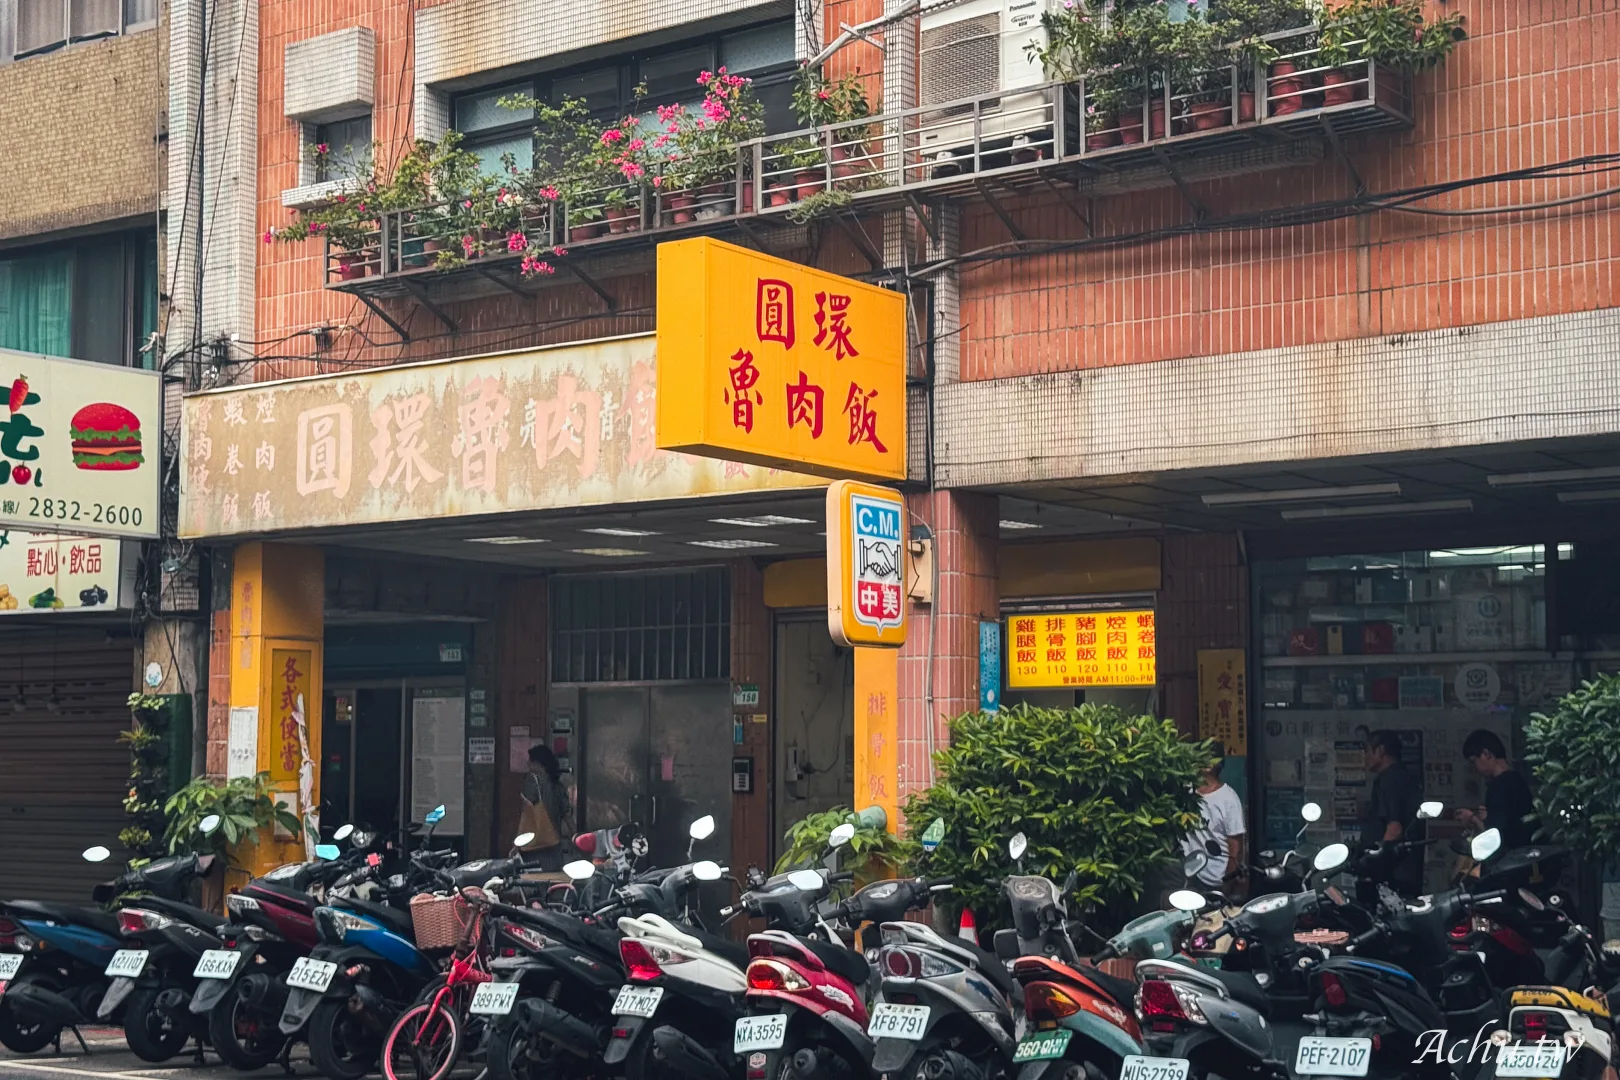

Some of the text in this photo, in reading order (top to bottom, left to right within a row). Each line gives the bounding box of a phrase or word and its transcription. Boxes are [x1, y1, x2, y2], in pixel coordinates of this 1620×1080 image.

[756, 277, 860, 361] 圓環
[723, 347, 889, 453] 魯肉飯
[0, 496, 143, 526] 線/ 2832-2600
[858, 509, 899, 540] C.M.
[861, 585, 898, 616] 中美
[1015, 618, 1037, 663] 雞腿飯
[1045, 617, 1066, 662] 排骨飯
[1075, 616, 1097, 661] 豬腳飯
[1017, 666, 1037, 676] 130
[1046, 665, 1067, 675] 110
[1078, 664, 1099, 674] 120
[1107, 663, 1128, 673] 110
[280, 656, 304, 773] 各式便當
